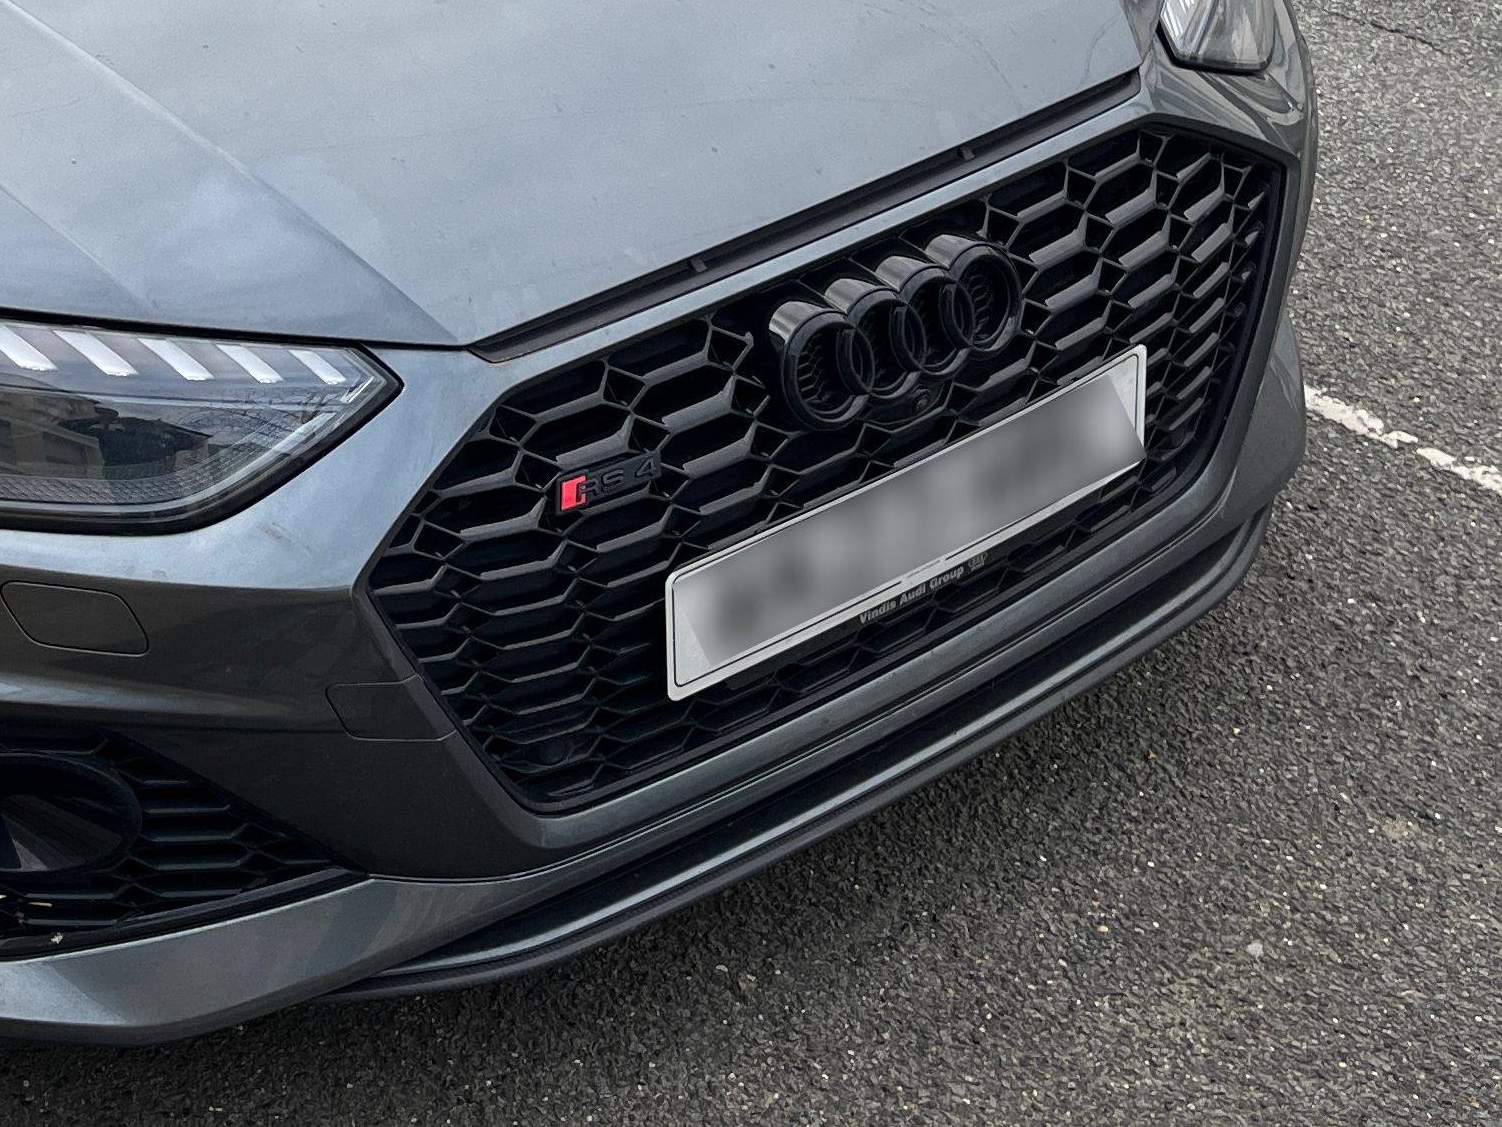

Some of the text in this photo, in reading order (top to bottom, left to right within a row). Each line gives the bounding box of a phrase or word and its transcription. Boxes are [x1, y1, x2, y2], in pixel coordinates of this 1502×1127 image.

[635, 457, 658, 478] 4
[859, 599, 897, 624] Vindis
[900, 583, 927, 606] Audi
[929, 565, 965, 590] Group
